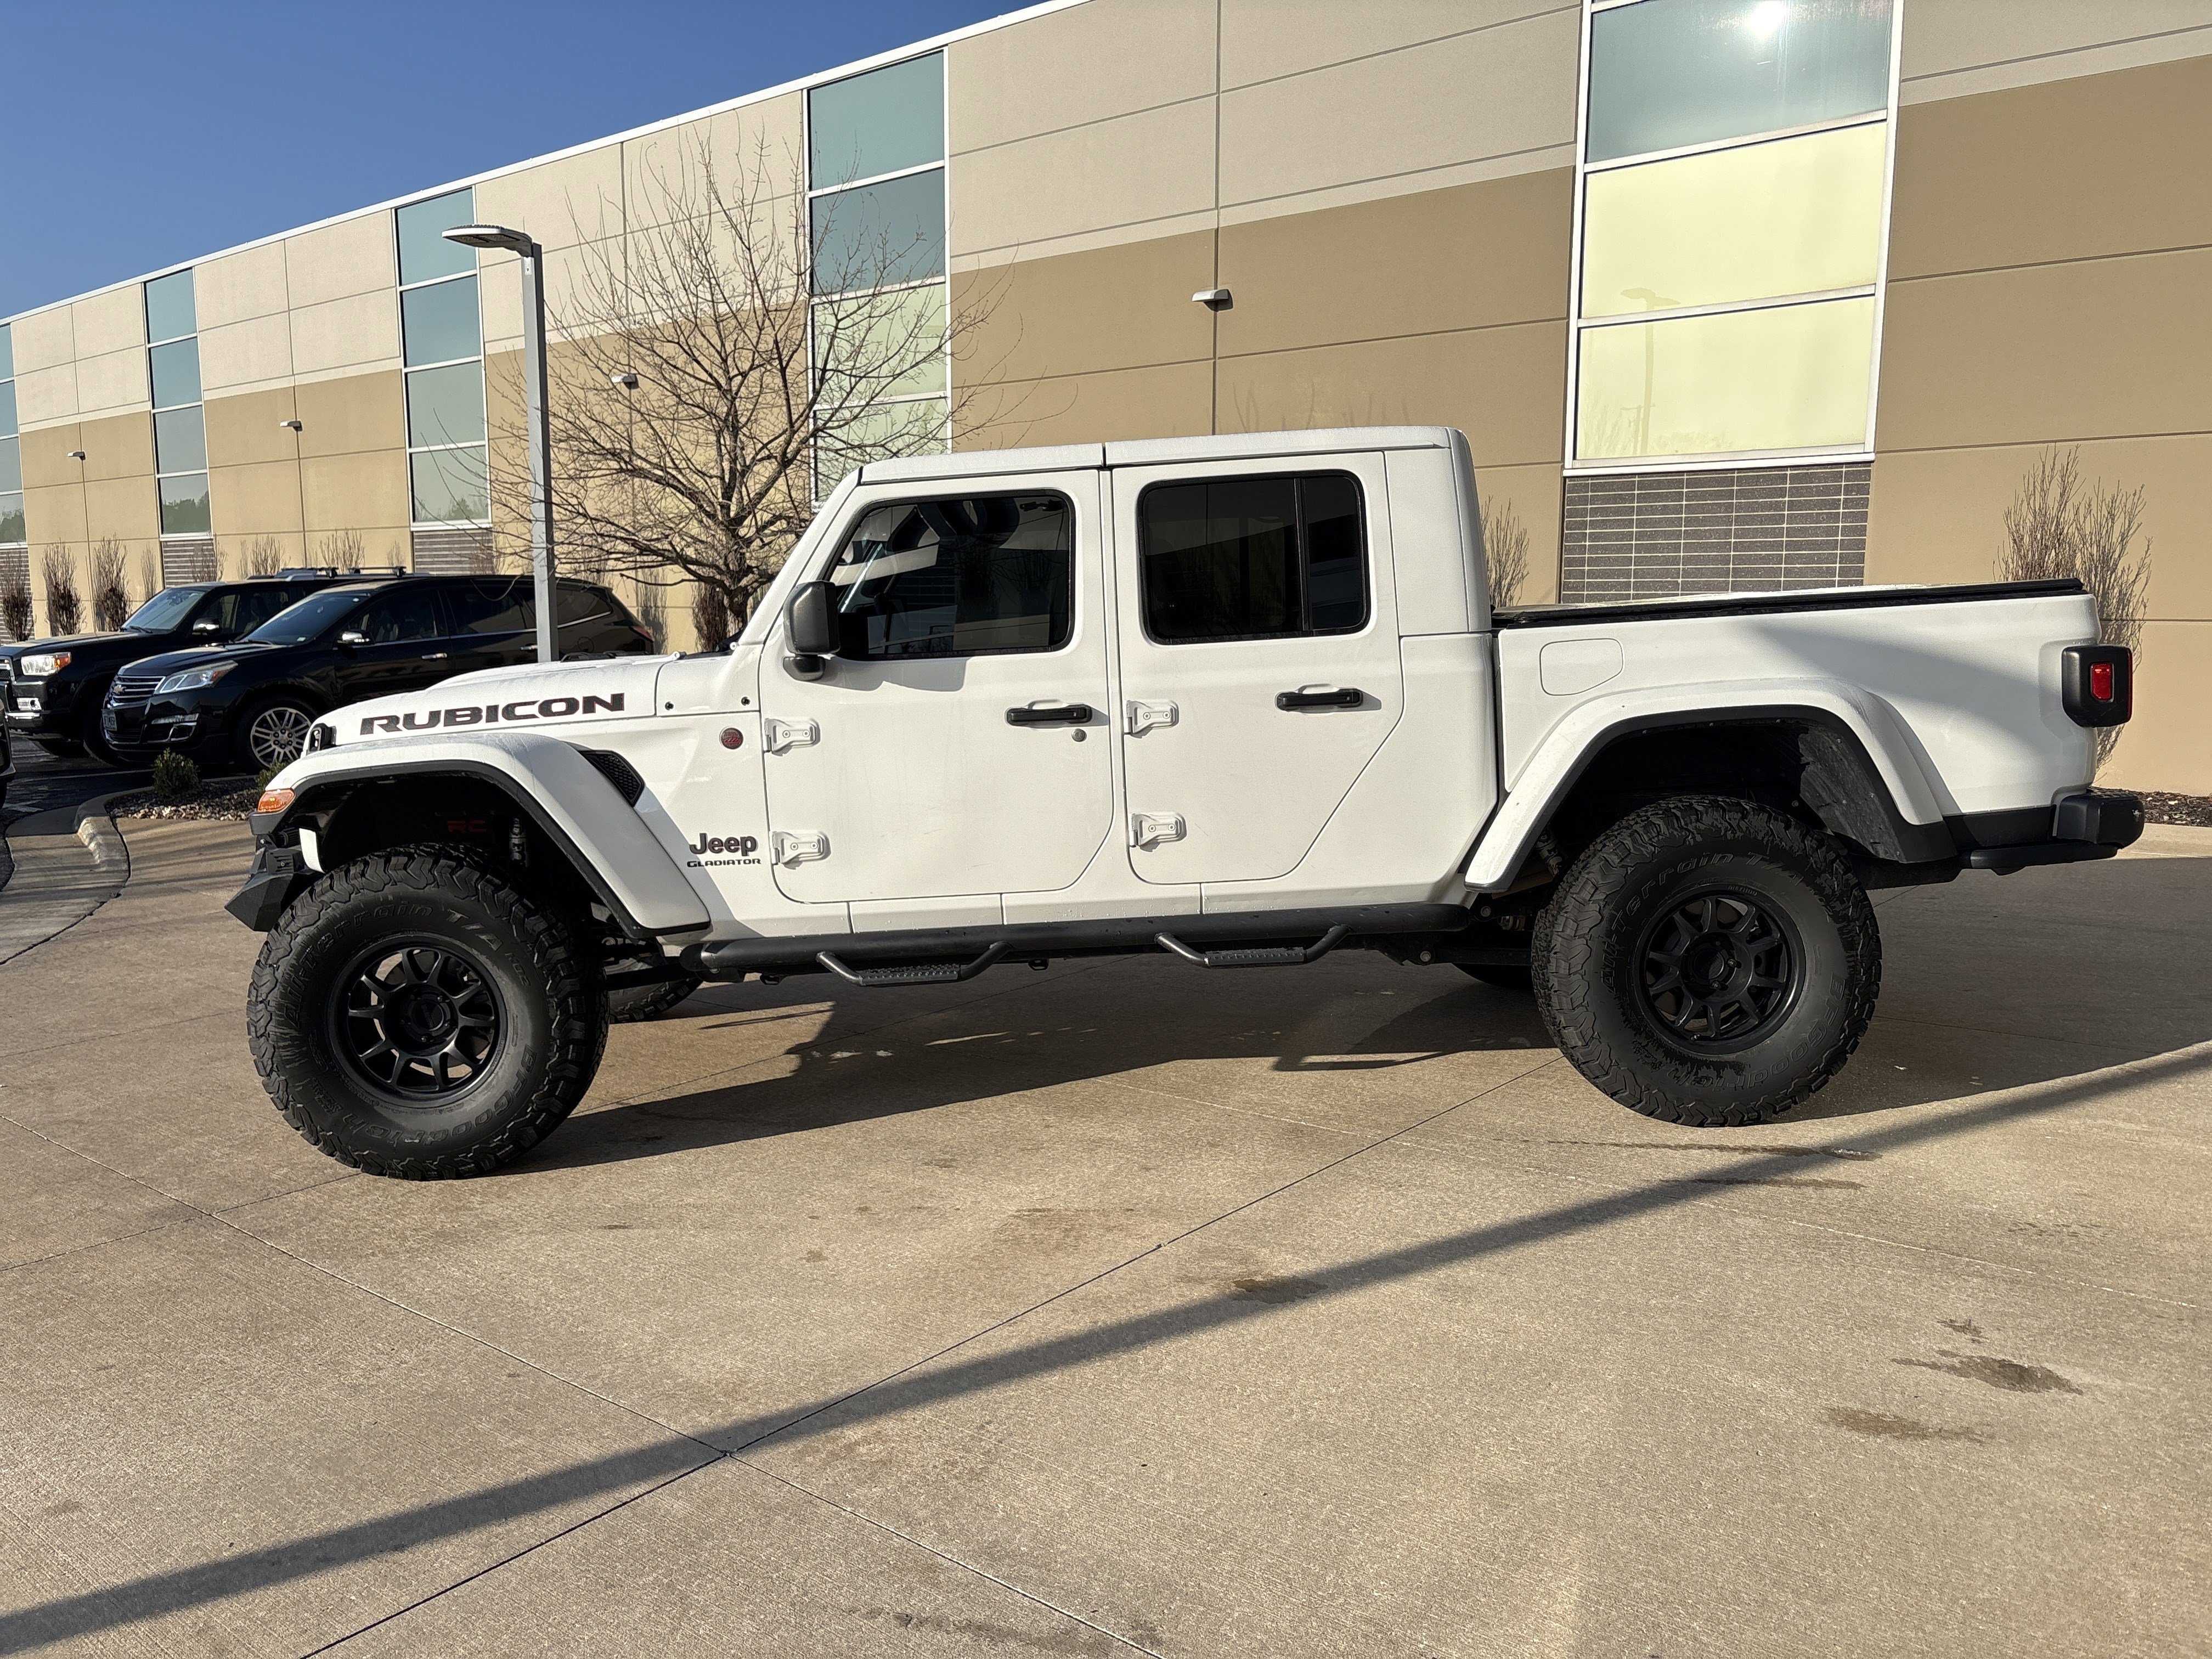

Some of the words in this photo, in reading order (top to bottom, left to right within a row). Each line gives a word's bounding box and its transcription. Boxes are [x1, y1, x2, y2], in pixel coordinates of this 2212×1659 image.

[360, 692, 625, 736] RUBICON
[689, 832, 758, 857] Jeep
[686, 858, 762, 867] GLADIATOR
[445, 908, 504, 952] T/A
